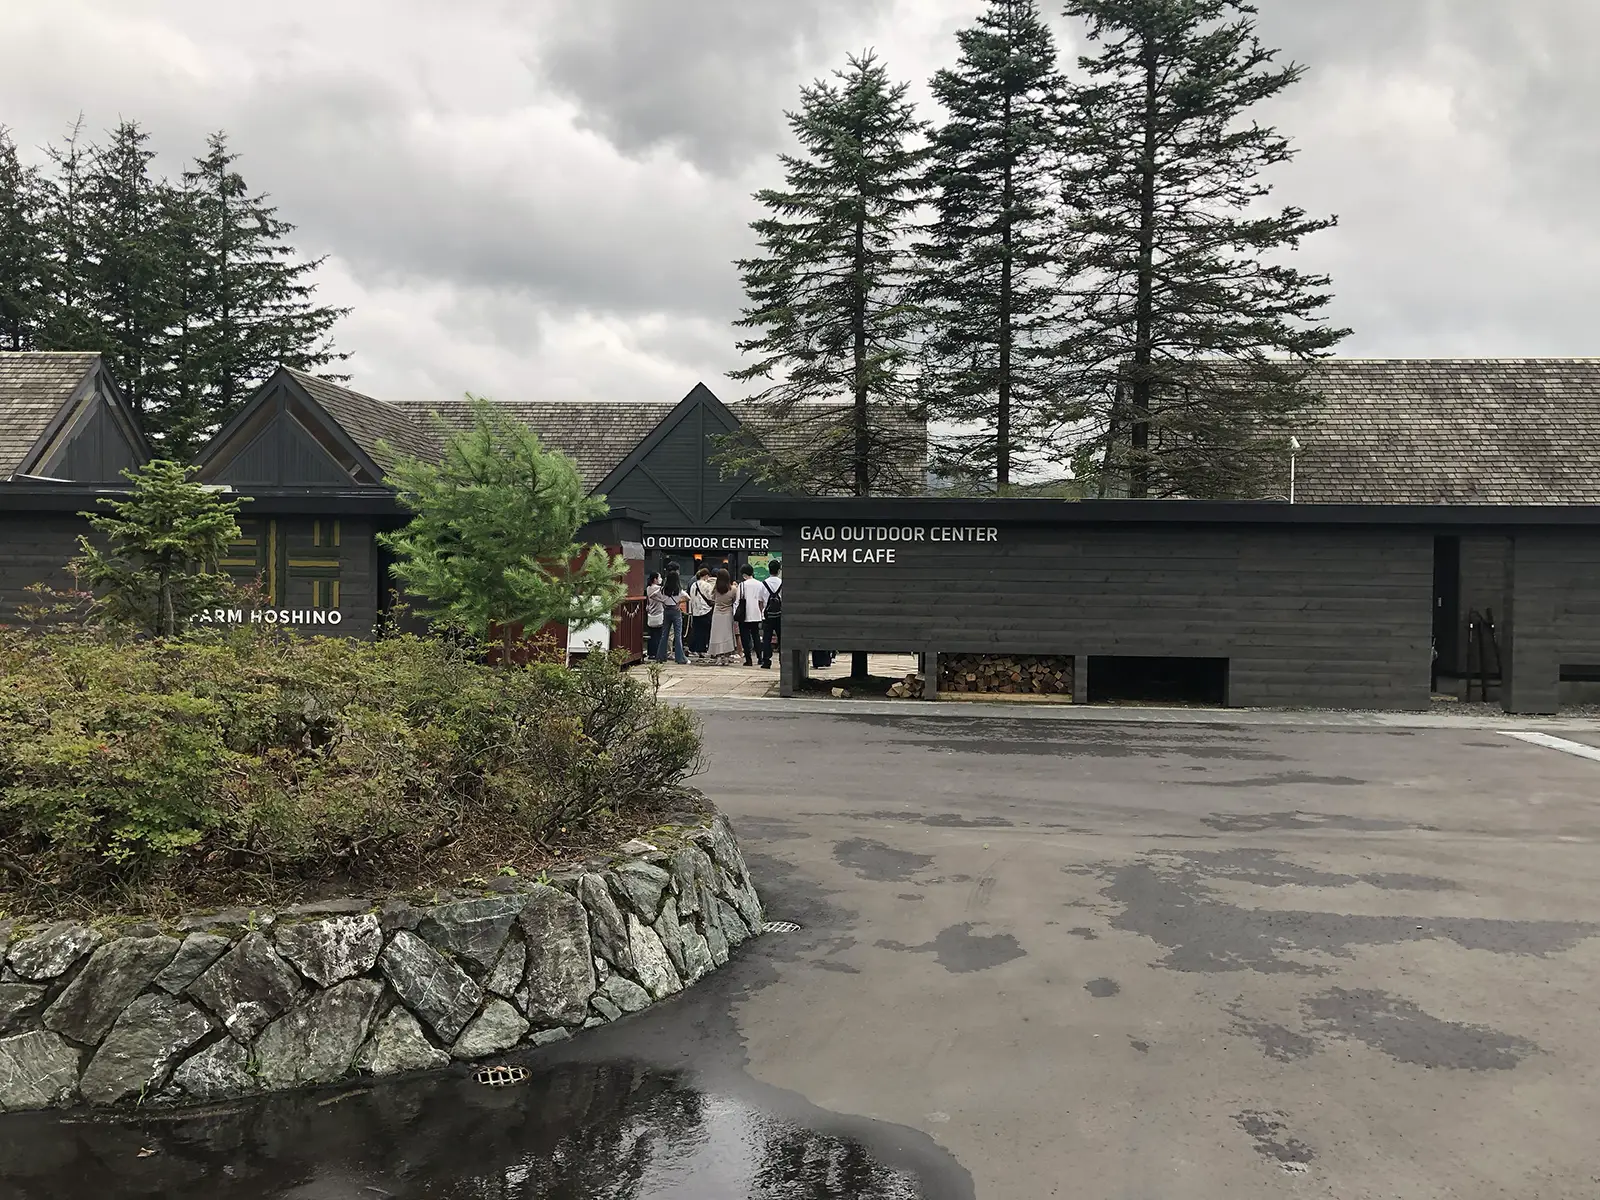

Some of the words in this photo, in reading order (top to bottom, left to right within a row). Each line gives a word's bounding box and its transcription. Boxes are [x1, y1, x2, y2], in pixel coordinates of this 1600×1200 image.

[800, 526, 836, 541] GAO
[840, 526, 925, 542] OUTDOOR
[930, 526, 998, 542] CENTER
[658, 536, 718, 549] OUTDOOR
[721, 538, 769, 549] CENTER
[800, 548, 847, 563] FARM
[852, 548, 896, 563] CAFE
[250, 610, 342, 625] HOSHINO
